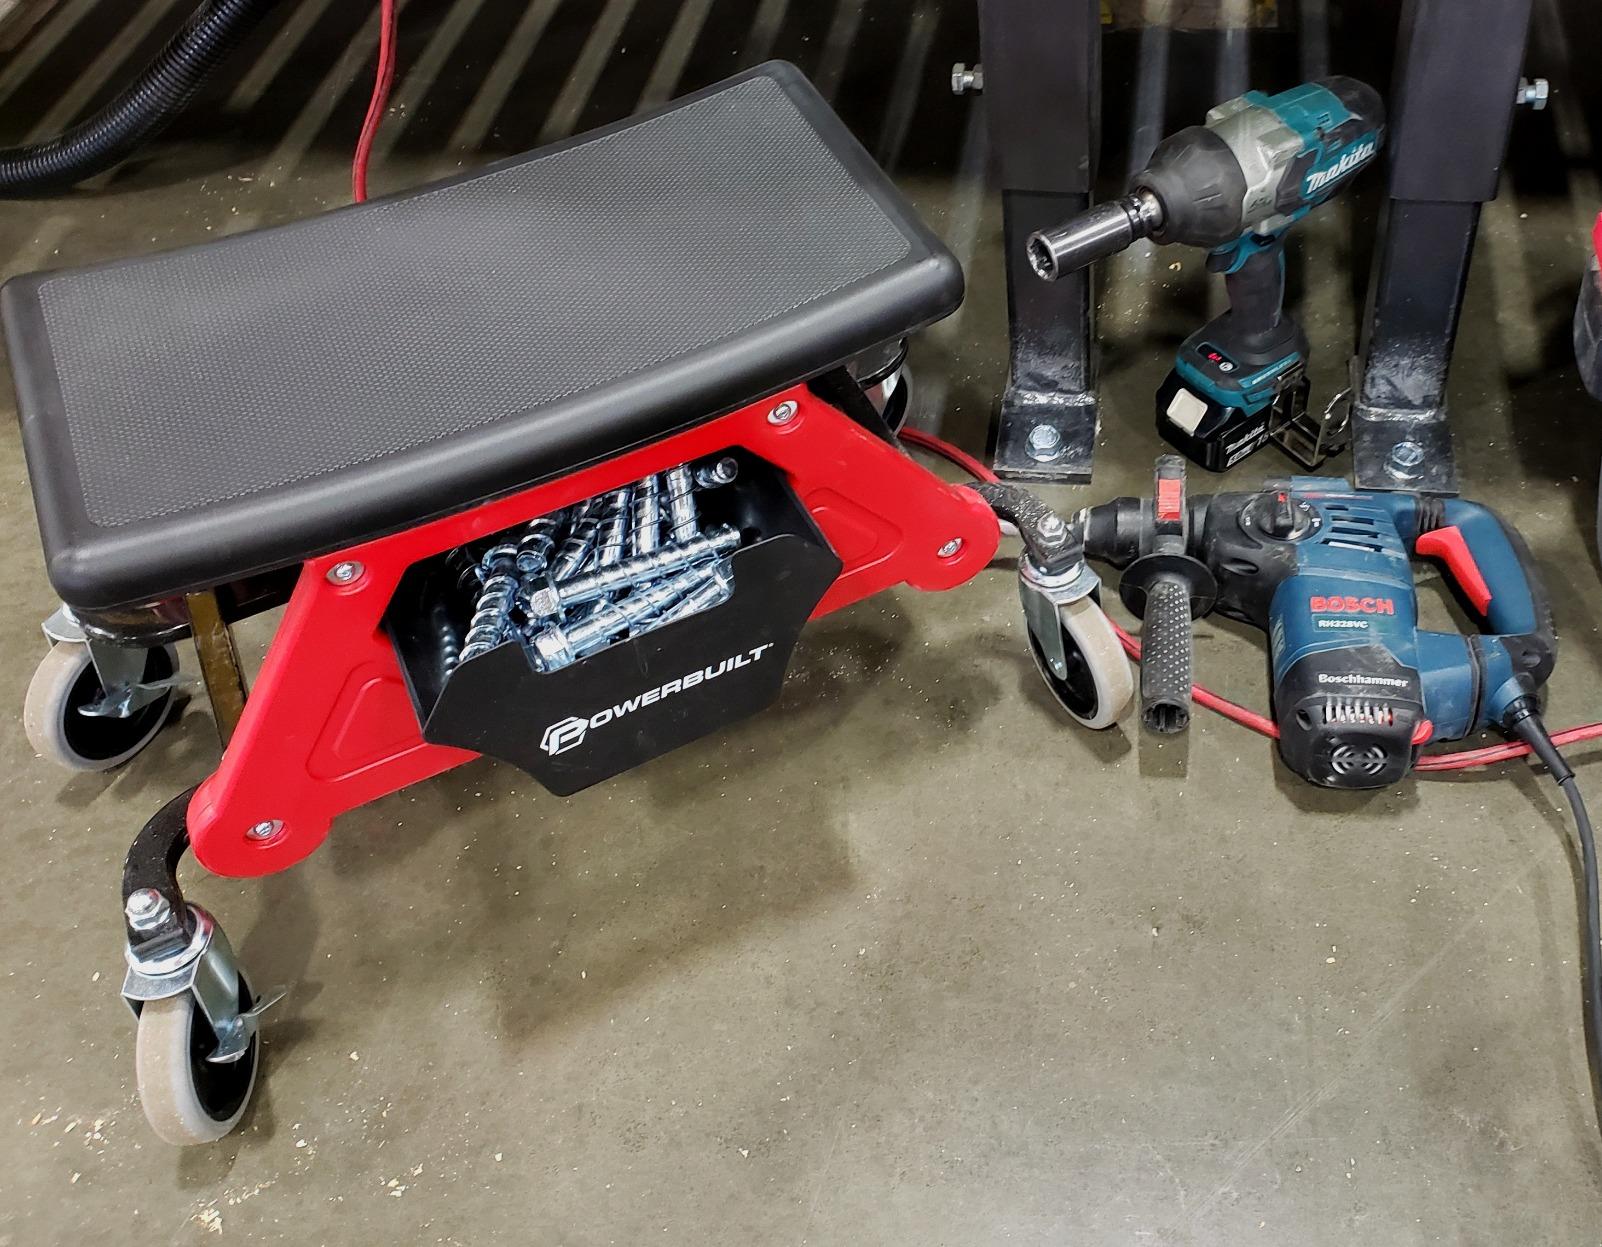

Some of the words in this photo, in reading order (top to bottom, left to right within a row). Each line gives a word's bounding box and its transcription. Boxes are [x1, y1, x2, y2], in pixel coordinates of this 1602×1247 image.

[1310, 596, 1394, 615] BOSCH
[1318, 673, 1409, 687] Boschhammer
[540, 644, 772, 756] POWERBUILT
